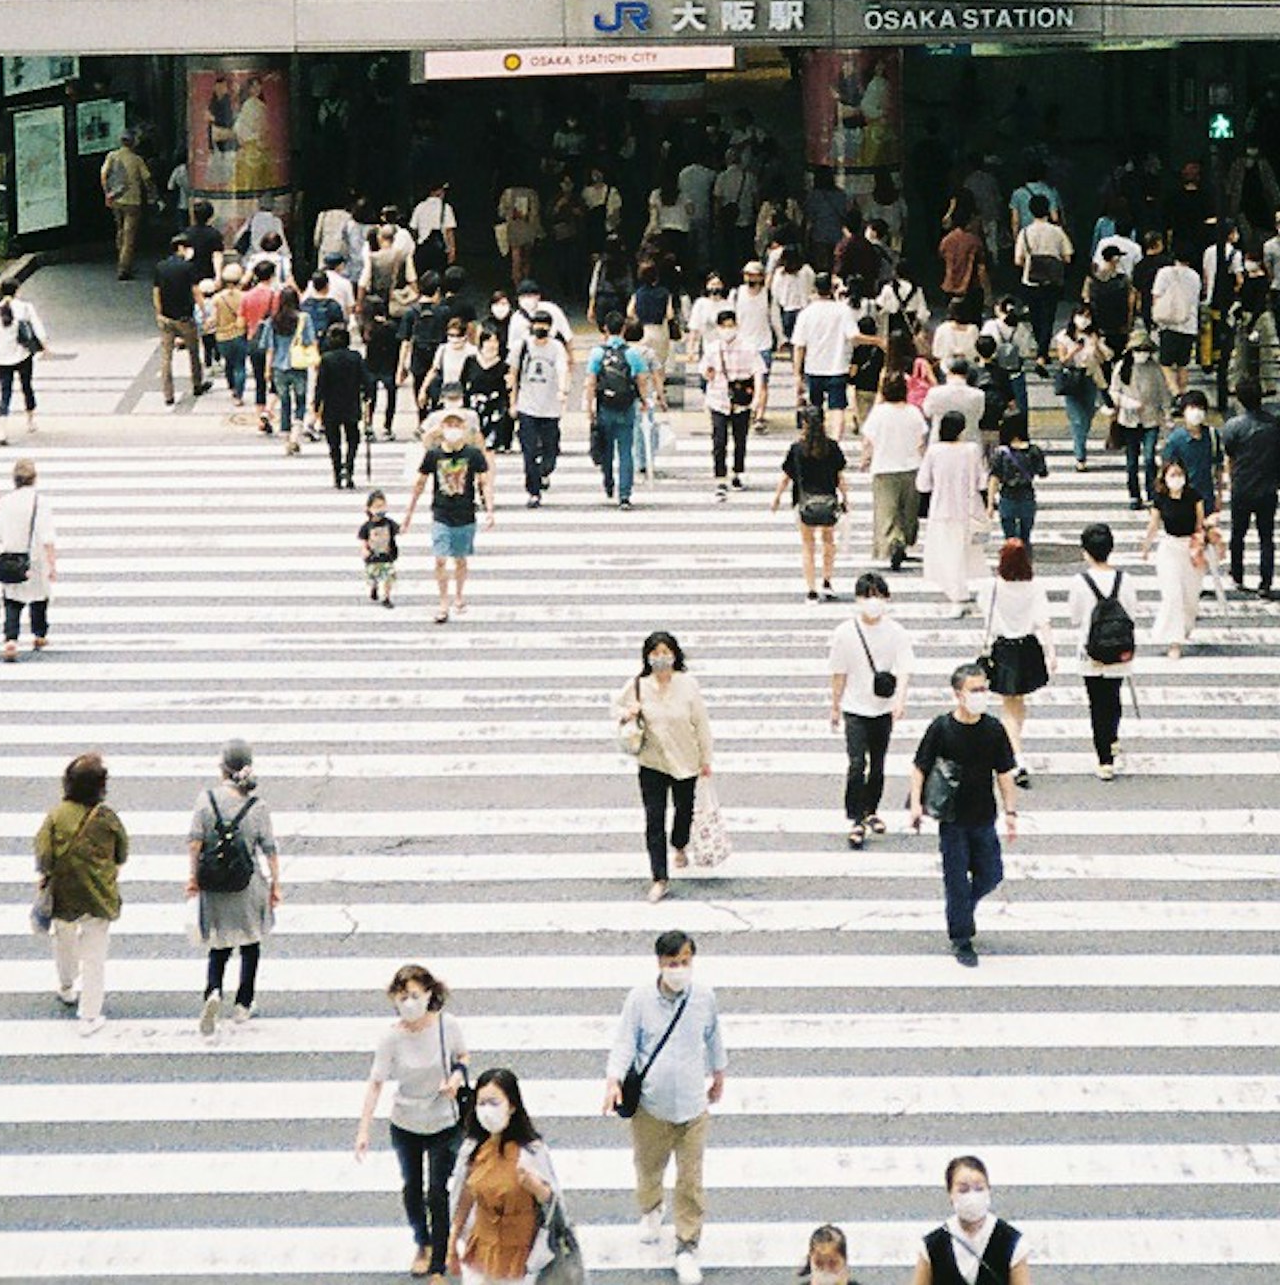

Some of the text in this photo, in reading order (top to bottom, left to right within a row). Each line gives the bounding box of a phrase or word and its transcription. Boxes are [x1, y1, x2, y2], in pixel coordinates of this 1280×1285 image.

[593, 0, 805, 33] JR 大阪駅
[962, 8, 1074, 30] STATION
[530, 52, 658, 67] OSAKA STATION CITY
